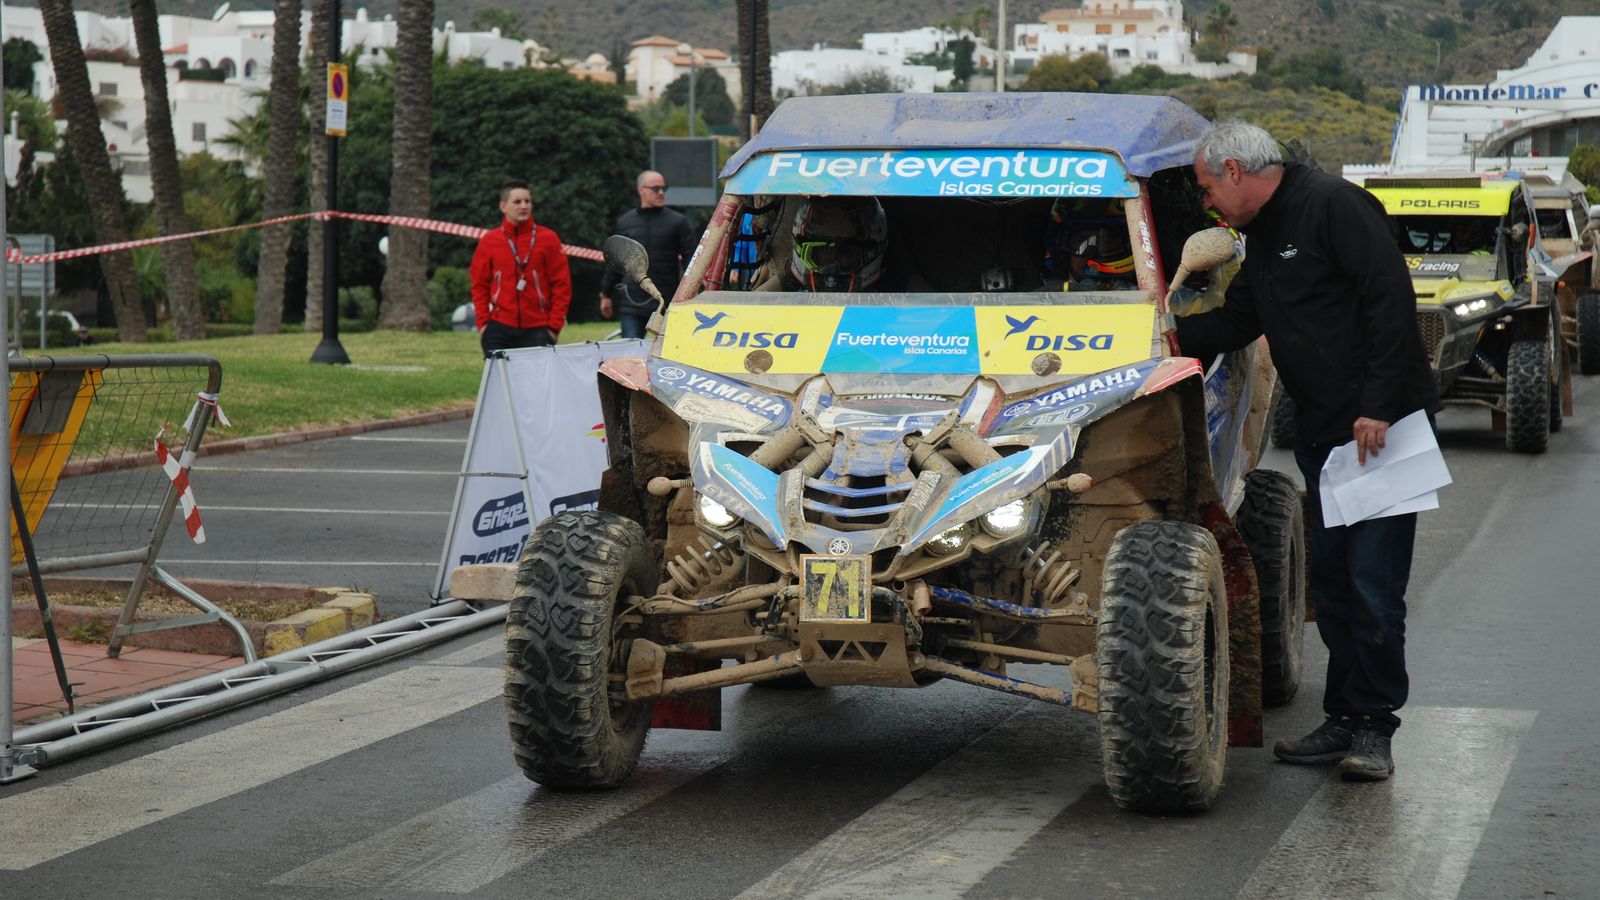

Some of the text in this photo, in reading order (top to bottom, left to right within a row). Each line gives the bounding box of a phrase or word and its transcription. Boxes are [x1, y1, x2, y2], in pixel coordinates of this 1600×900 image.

[767, 151, 1108, 178] Fuerteventura
[939, 181, 1102, 195] Islas Canarias
[1400, 199, 1480, 209] POLARIS
[1418, 261, 1460, 272] racing
[836, 332, 970, 347] Fuerteventura
[904, 347, 968, 355] Islas Canarias
[686, 373, 785, 416] YAMAHA
[1033, 367, 1142, 407] YAMAHA
[811, 560, 860, 617] 71
